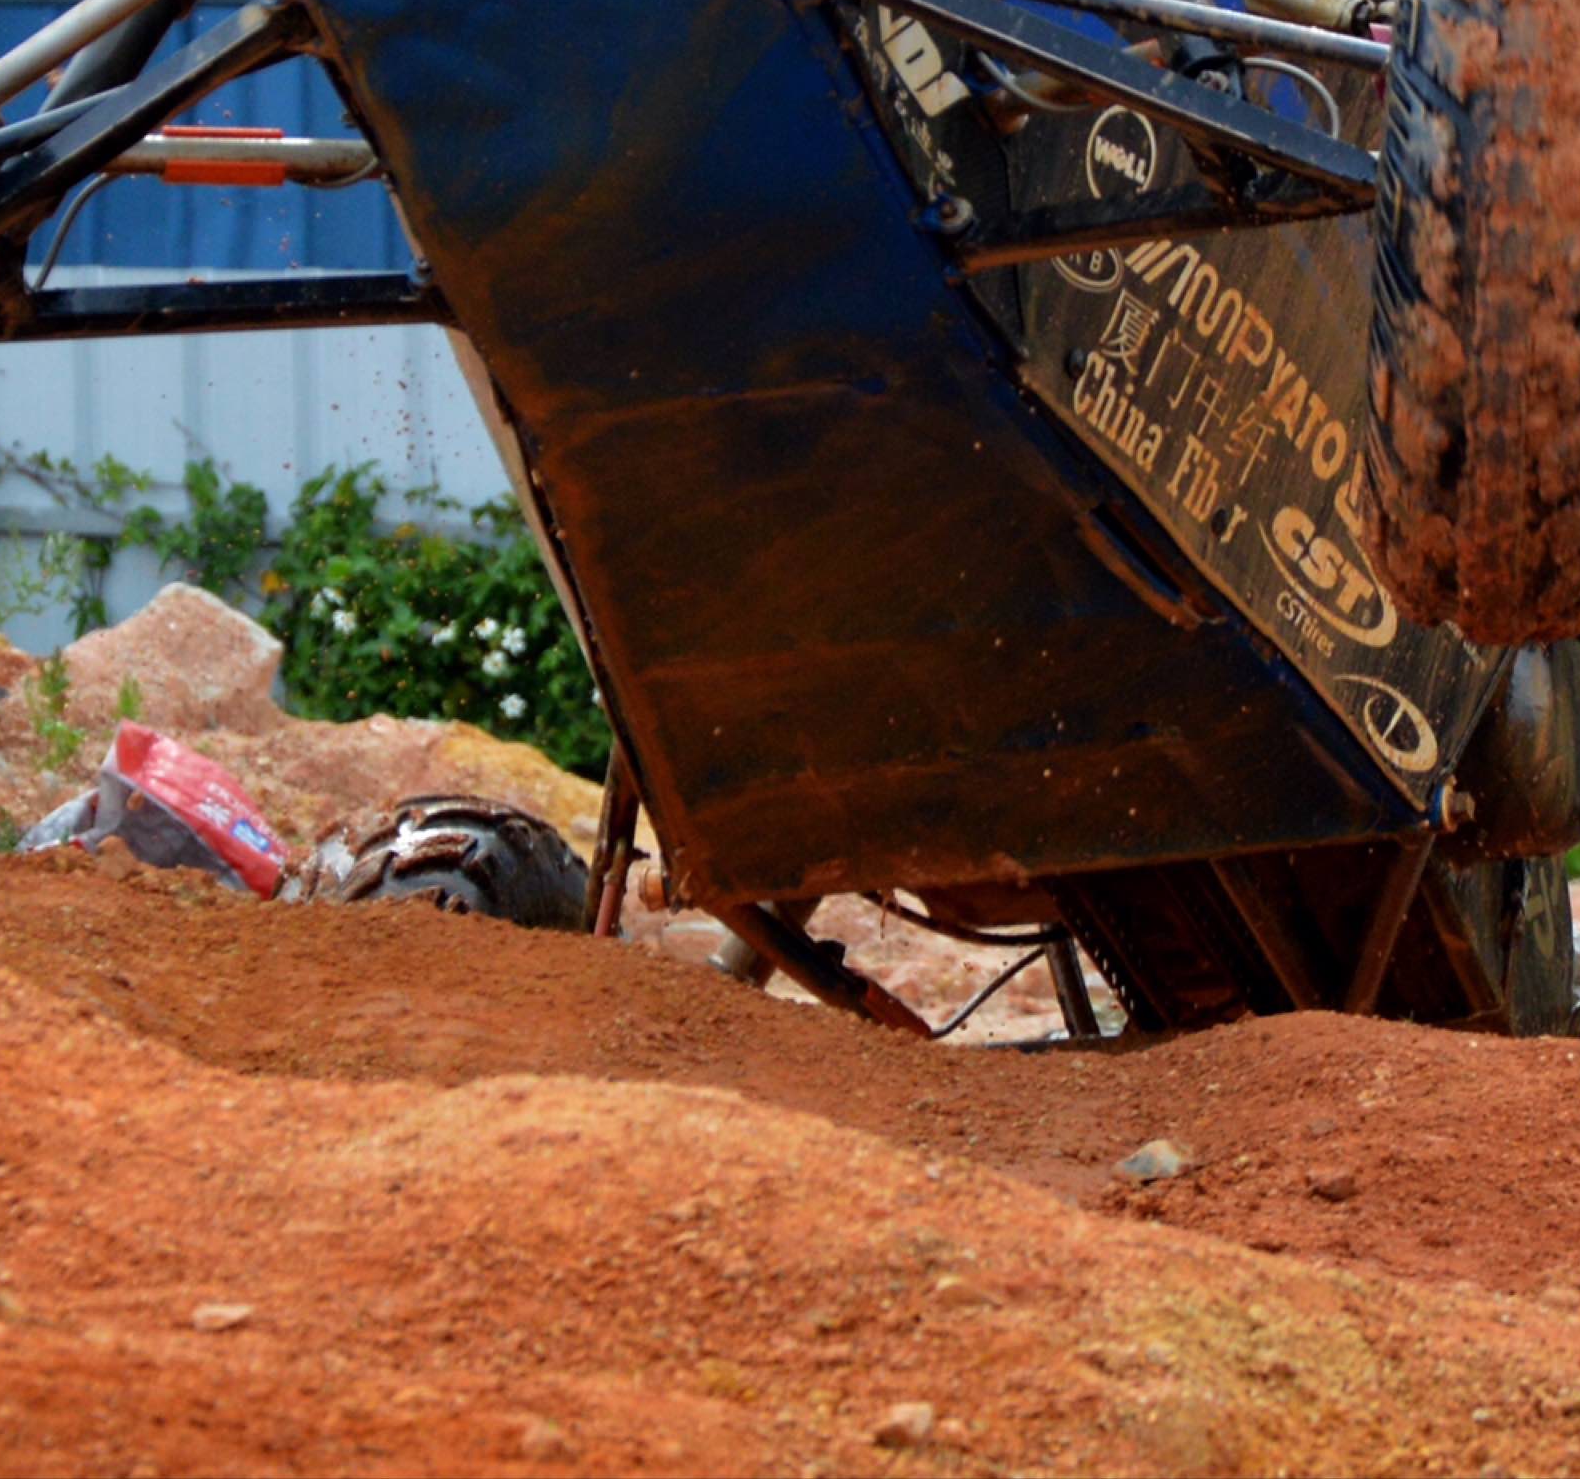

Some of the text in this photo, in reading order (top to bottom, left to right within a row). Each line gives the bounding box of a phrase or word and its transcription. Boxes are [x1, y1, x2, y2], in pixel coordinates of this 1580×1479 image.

[1073, 350, 1166, 473] China
[1167, 432, 1248, 545] Fibr
[1272, 505, 1377, 615] CST
